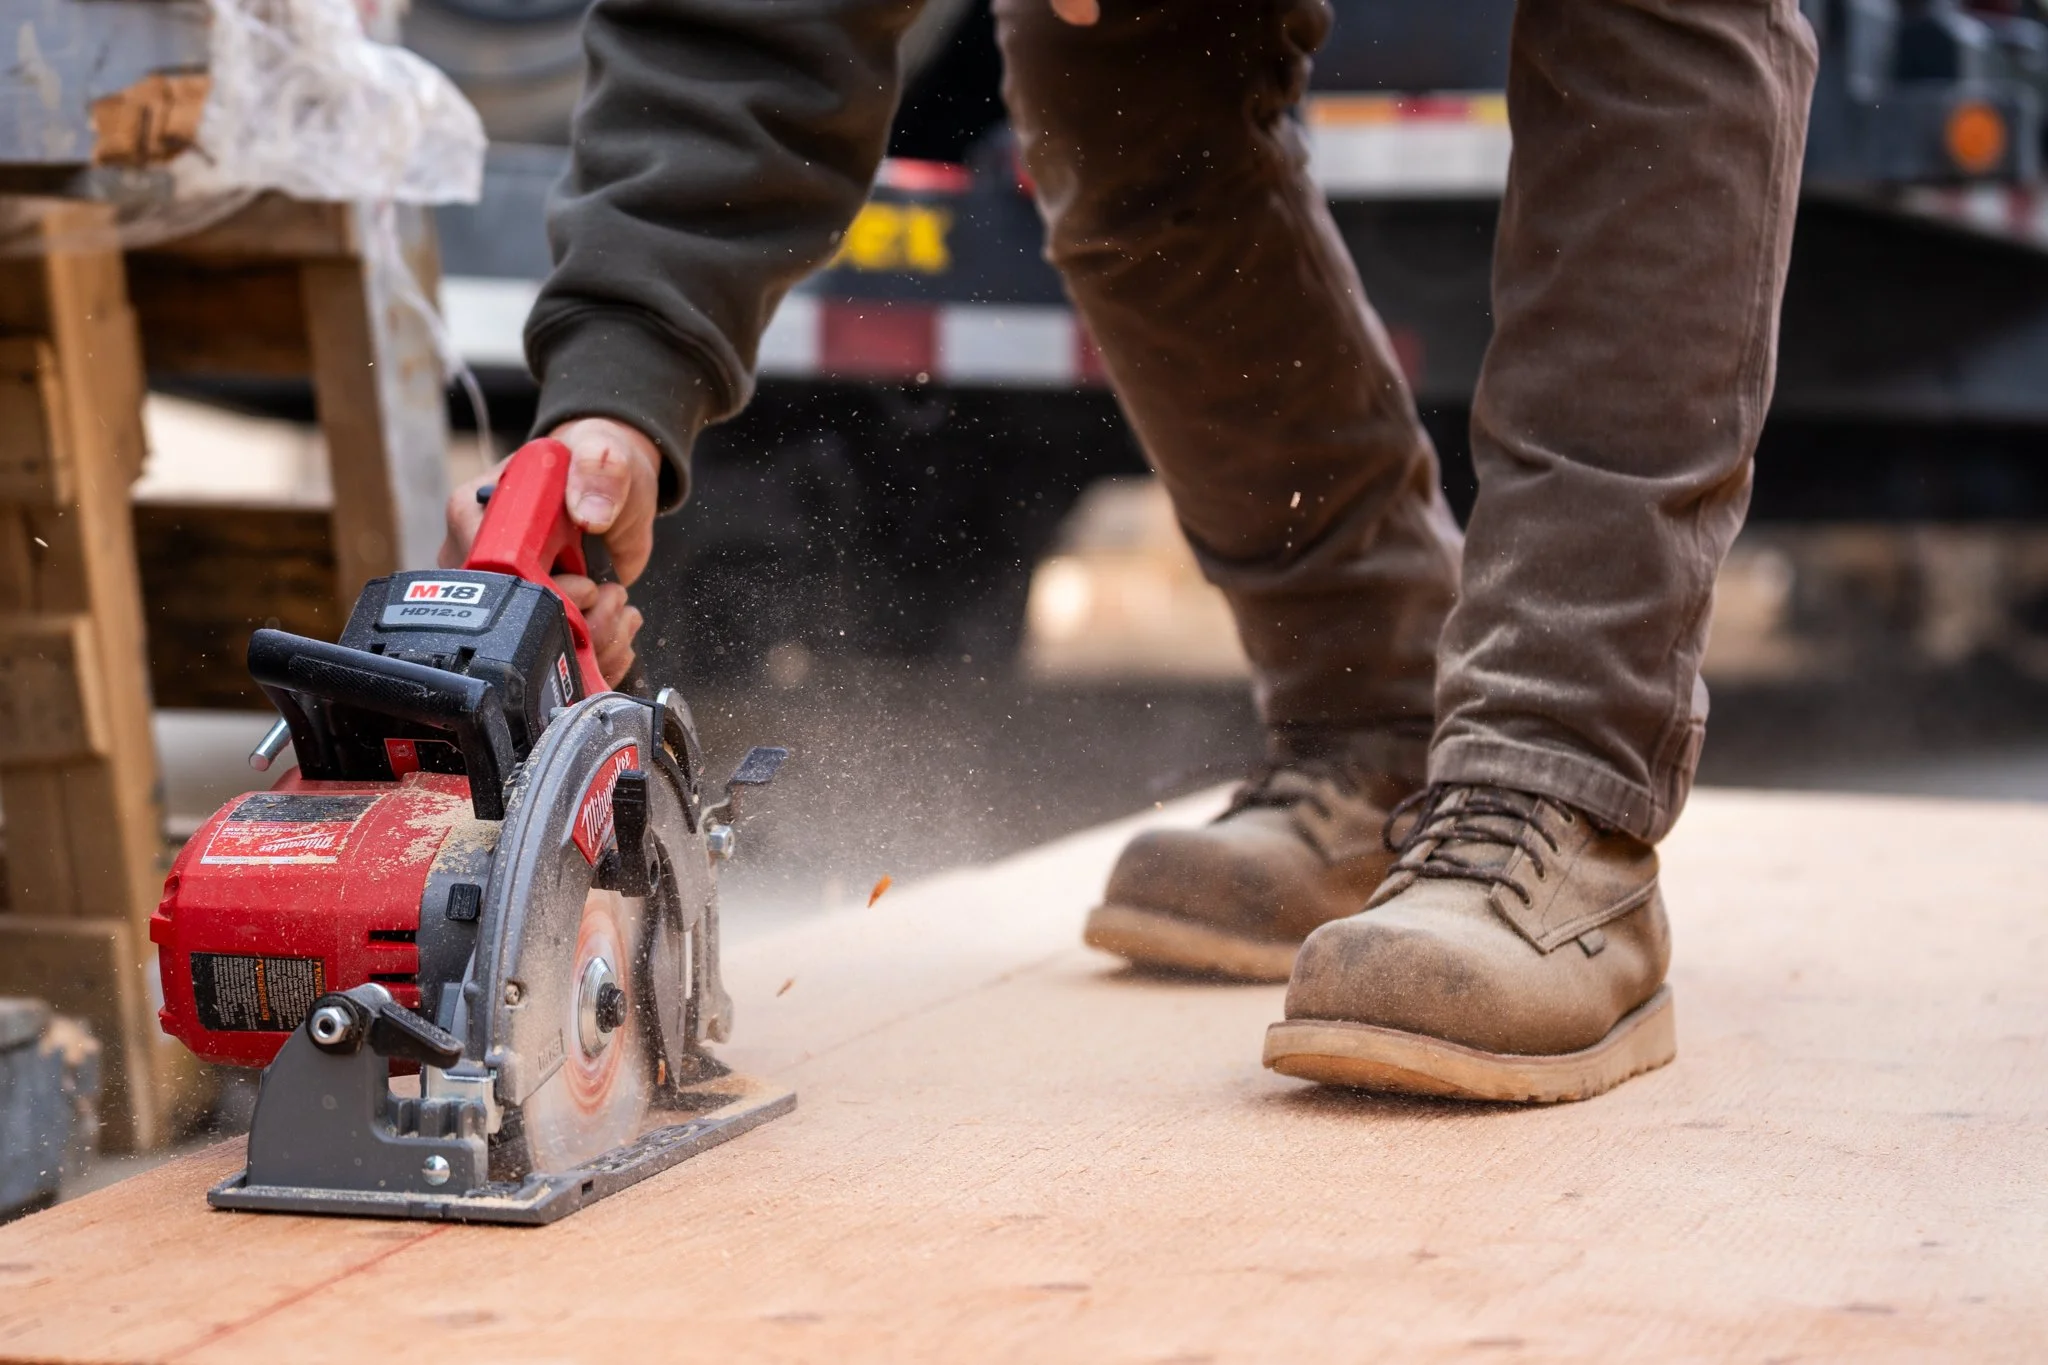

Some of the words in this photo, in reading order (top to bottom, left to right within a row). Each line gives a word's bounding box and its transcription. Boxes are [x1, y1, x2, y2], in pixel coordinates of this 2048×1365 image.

[409, 584, 479, 599] M18
[399, 607, 472, 618] HD12.0
[559, 656, 572, 698] M18
[259, 834, 336, 852] Milwaukee
